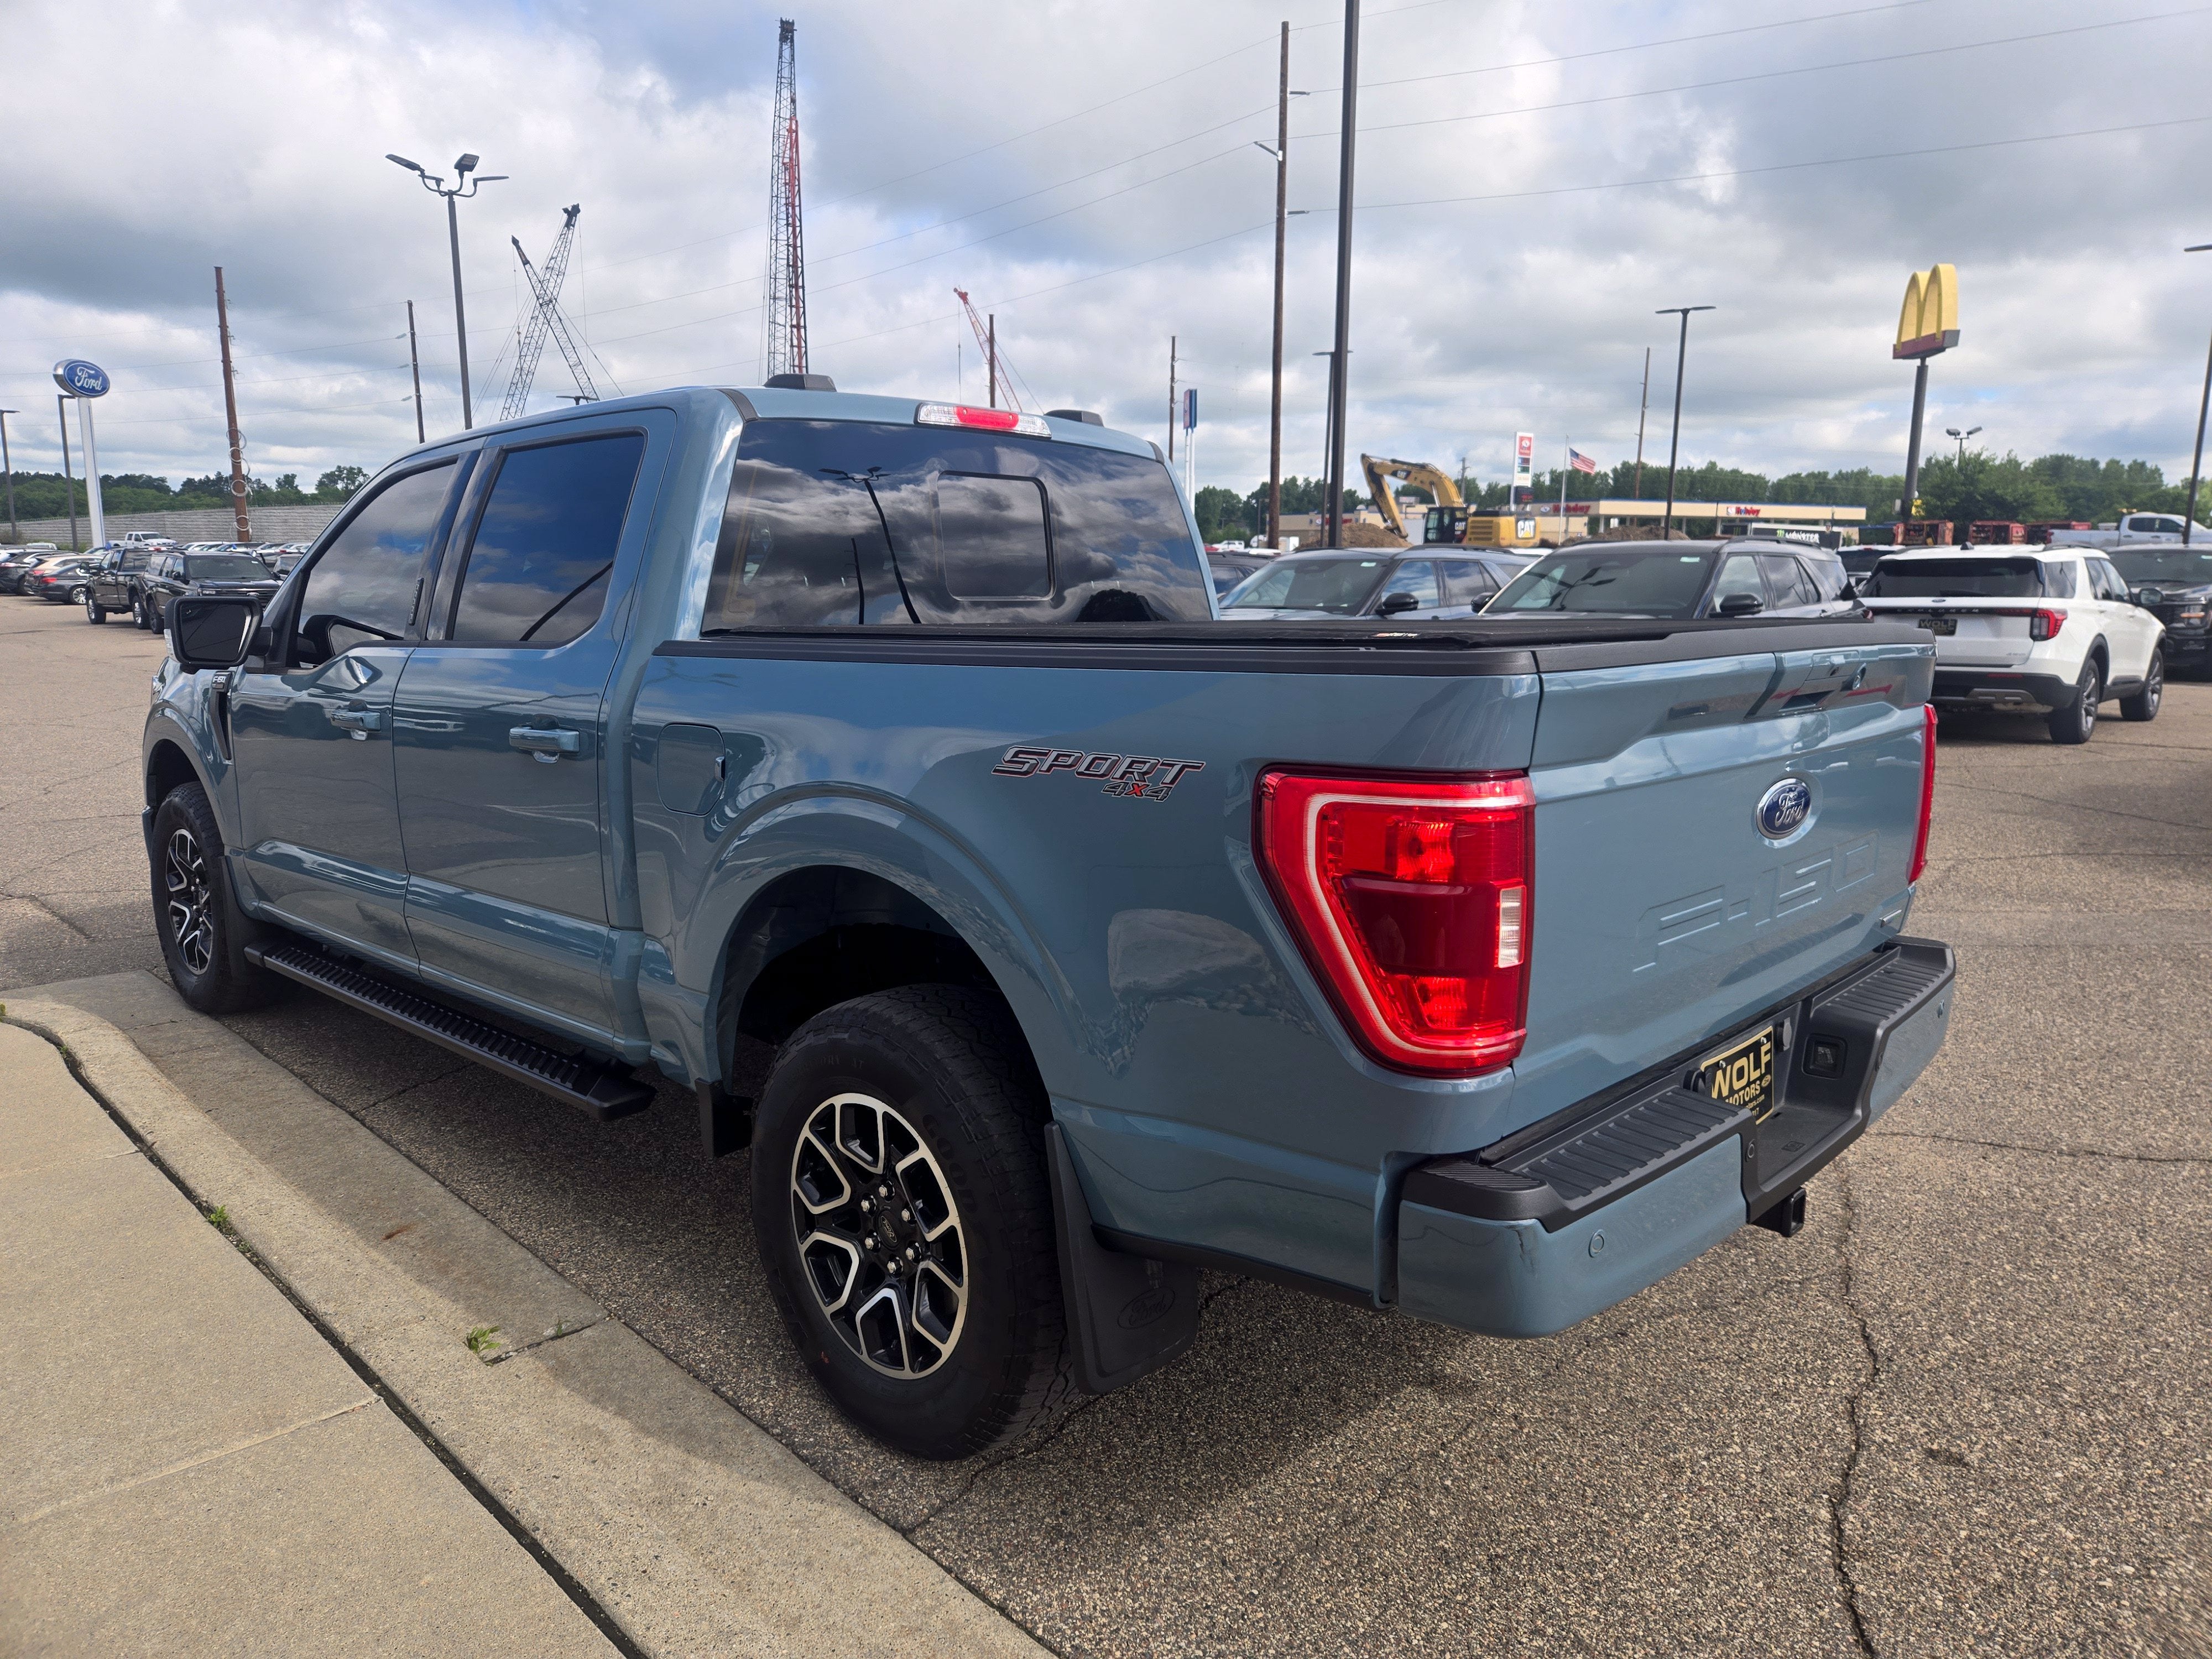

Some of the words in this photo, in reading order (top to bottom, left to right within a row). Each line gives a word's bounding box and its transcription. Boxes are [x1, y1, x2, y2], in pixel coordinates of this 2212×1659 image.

[75, 367, 102, 390] Ford
[1454, 522, 1466, 530] CAT
[1517, 520, 1535, 538] CAT
[1921, 619, 1955, 628] WOLF
[992, 745, 1206, 786] SPORT
[1775, 792, 1805, 827] Ford
[1633, 829, 1879, 972] F-150
